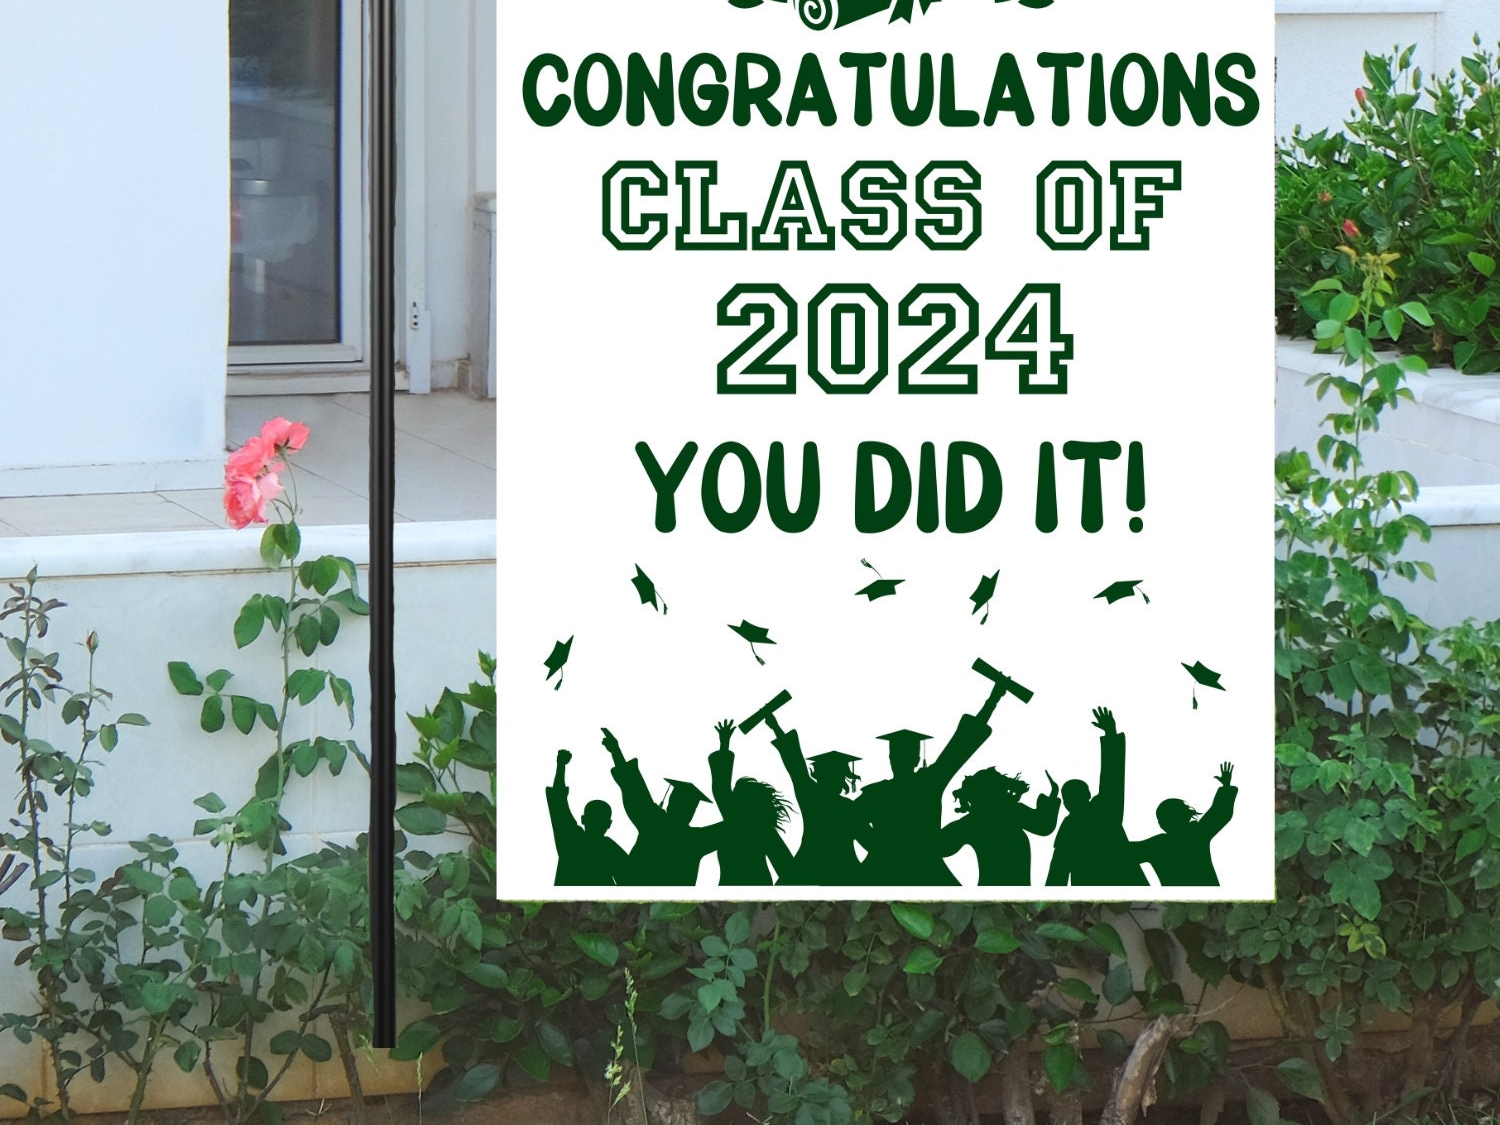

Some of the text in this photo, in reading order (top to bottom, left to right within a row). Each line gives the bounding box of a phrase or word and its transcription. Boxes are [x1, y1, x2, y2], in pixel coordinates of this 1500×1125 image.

[522, 51, 1260, 128] CONGRATULATIONS
[601, 160, 1182, 251] CLASS OF
[716, 282, 1074, 395] 2024
[634, 440, 1146, 534] YOU DID IT!
